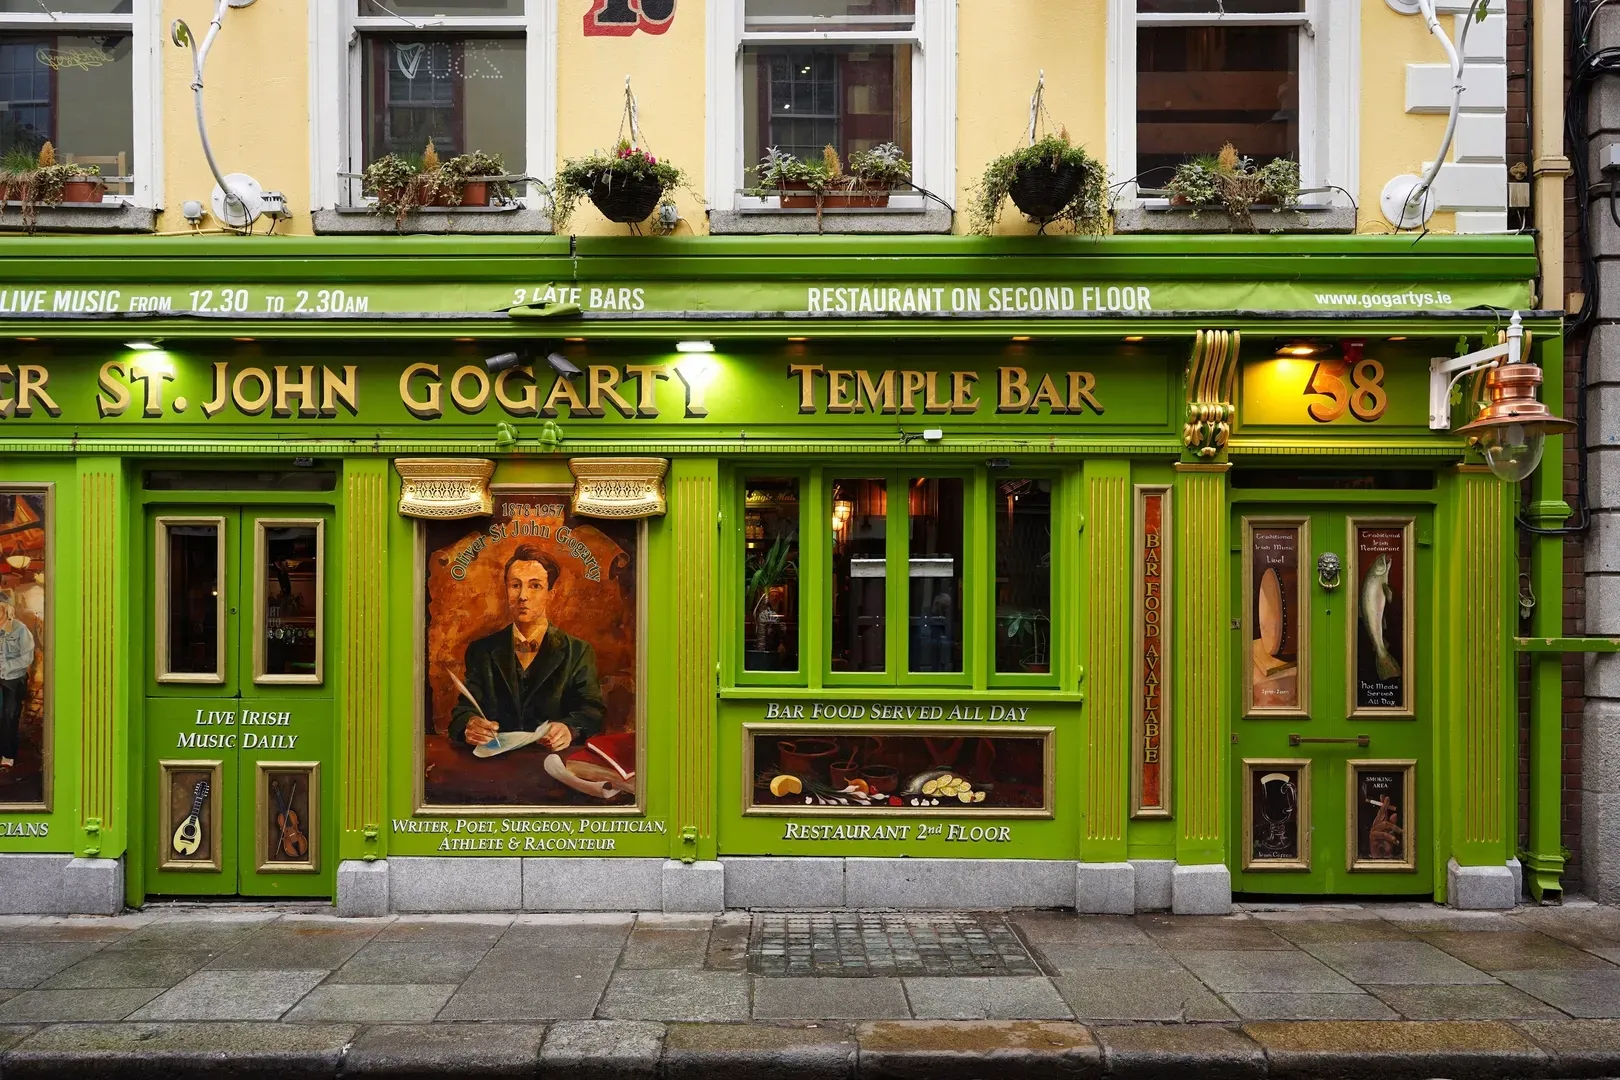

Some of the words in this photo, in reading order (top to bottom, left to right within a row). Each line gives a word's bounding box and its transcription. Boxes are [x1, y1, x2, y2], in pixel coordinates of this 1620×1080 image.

[0, 290, 47, 313] LIVE
[53, 289, 120, 313] MUSIC
[130, 296, 172, 313] FROM
[189, 289, 249, 313] 12.30
[266, 296, 285, 313] TO
[295, 289, 369, 313] 2.30AM
[512, 288, 527, 305] 3
[532, 287, 582, 307] LATE
[589, 287, 645, 311] BARS
[808, 287, 945, 312] RESTAURANT
[951, 287, 982, 312] ON
[988, 287, 1075, 312] SECOND
[1082, 286, 1151, 311] FLOOR
[1314, 291, 1452, 308] www.gogartys.ie
[97, 359, 187, 419] ST.
[200, 361, 359, 419] JOHN
[399, 361, 709, 420] GOGARTY
[787, 363, 981, 416] TEMPLE
[995, 366, 1105, 416] BAR
[1303, 358, 1388, 423] 58
[501, 502, 531, 517] 1878
[450, 534, 487, 581] Oliver
[488, 523, 507, 544] St
[510, 519, 550, 538] John
[554, 525, 601, 583] Gogarty
[1145, 533, 1160, 576] BAR
[1360, 544, 1400, 552] Restaurant
[1145, 582, 1160, 637] FOOD
[765, 703, 804, 719] BAR
[810, 703, 866, 719] FOOD
[869, 703, 943, 720] SERVED
[946, 704, 984, 720] ALL
[988, 705, 1030, 721] DAY
[1144, 643, 1159, 763] AVAILABLE
[195, 709, 235, 726] LIVE
[241, 710, 291, 726] IRISH
[176, 732, 237, 748] MUSIC
[242, 732, 298, 749] DAILY
[391, 819, 451, 836] WRITER,
[454, 819, 498, 836] POET,
[500, 819, 576, 837] SURGEON,
[578, 820, 668, 837] POLITICIAN,
[783, 822, 911, 840] RESTAURANT
[916, 823, 943, 840] 2nd
[945, 824, 1012, 841] FLOOR
[437, 837, 504, 851] ATHLETE
[508, 836, 520, 850] &
[523, 837, 616, 851] RACONTEUR
